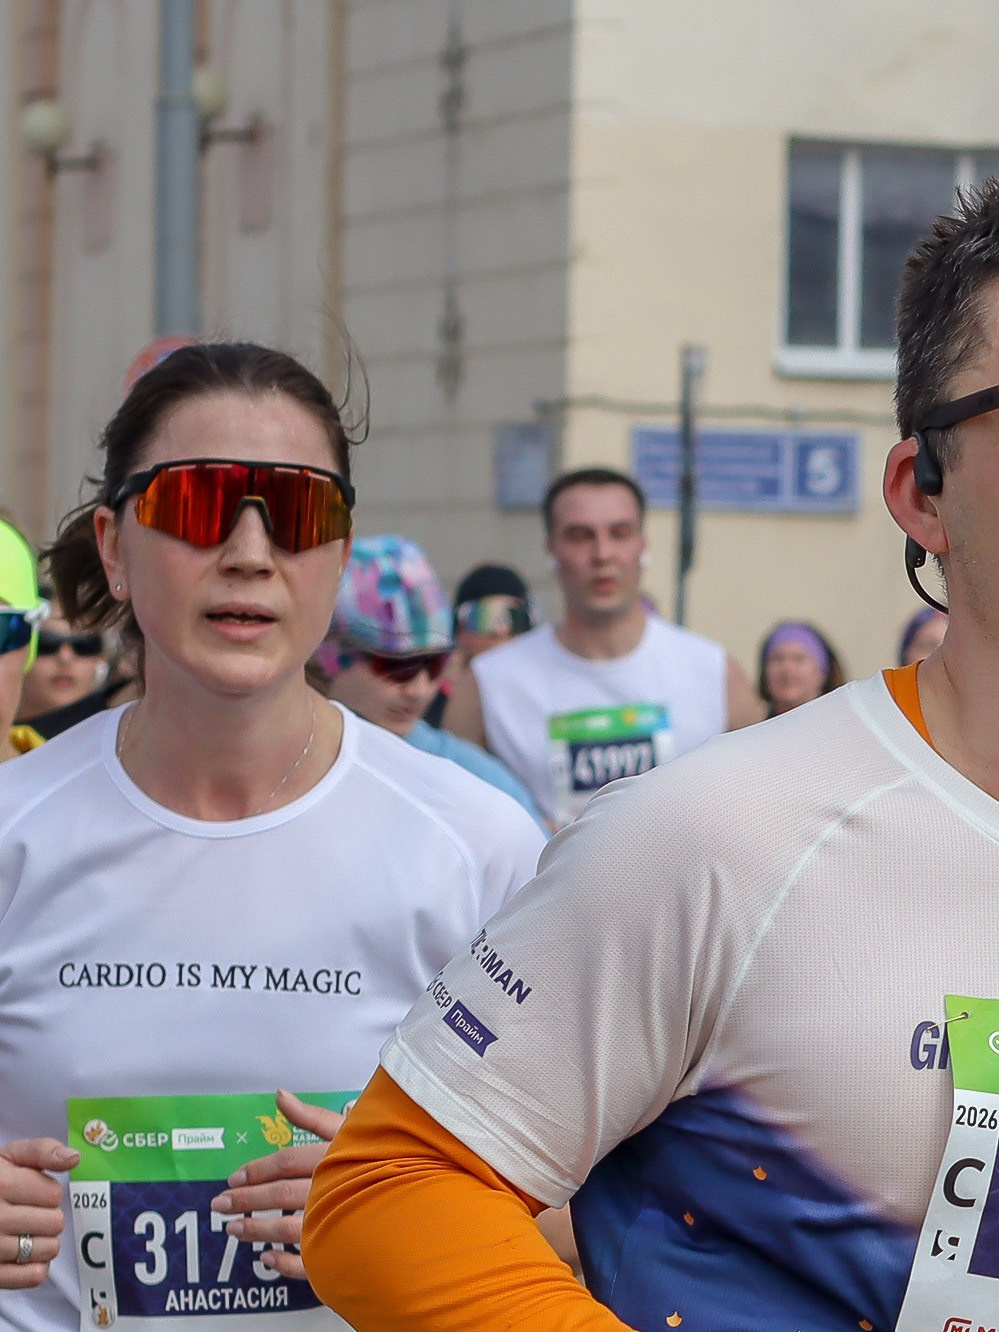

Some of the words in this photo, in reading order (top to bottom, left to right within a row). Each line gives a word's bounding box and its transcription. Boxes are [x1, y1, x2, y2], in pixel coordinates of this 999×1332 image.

[806, 447, 840, 495] 5
[59, 962, 166, 988] CARDIO
[175, 963, 202, 988] IS
[211, 964, 258, 989] MY
[264, 966, 362, 996] MAGIC
[432, 981, 453, 1009] СБЕР
[450, 1008, 484, 1045] Прайм
[955, 1105, 999, 1130] 2026
[122, 1132, 169, 1148] СБЕР
[177, 1132, 215, 1145] Прайм
[73, 1193, 108, 1209] 2026
[165, 1285, 289, 1312] АНАСТАСИЯ
